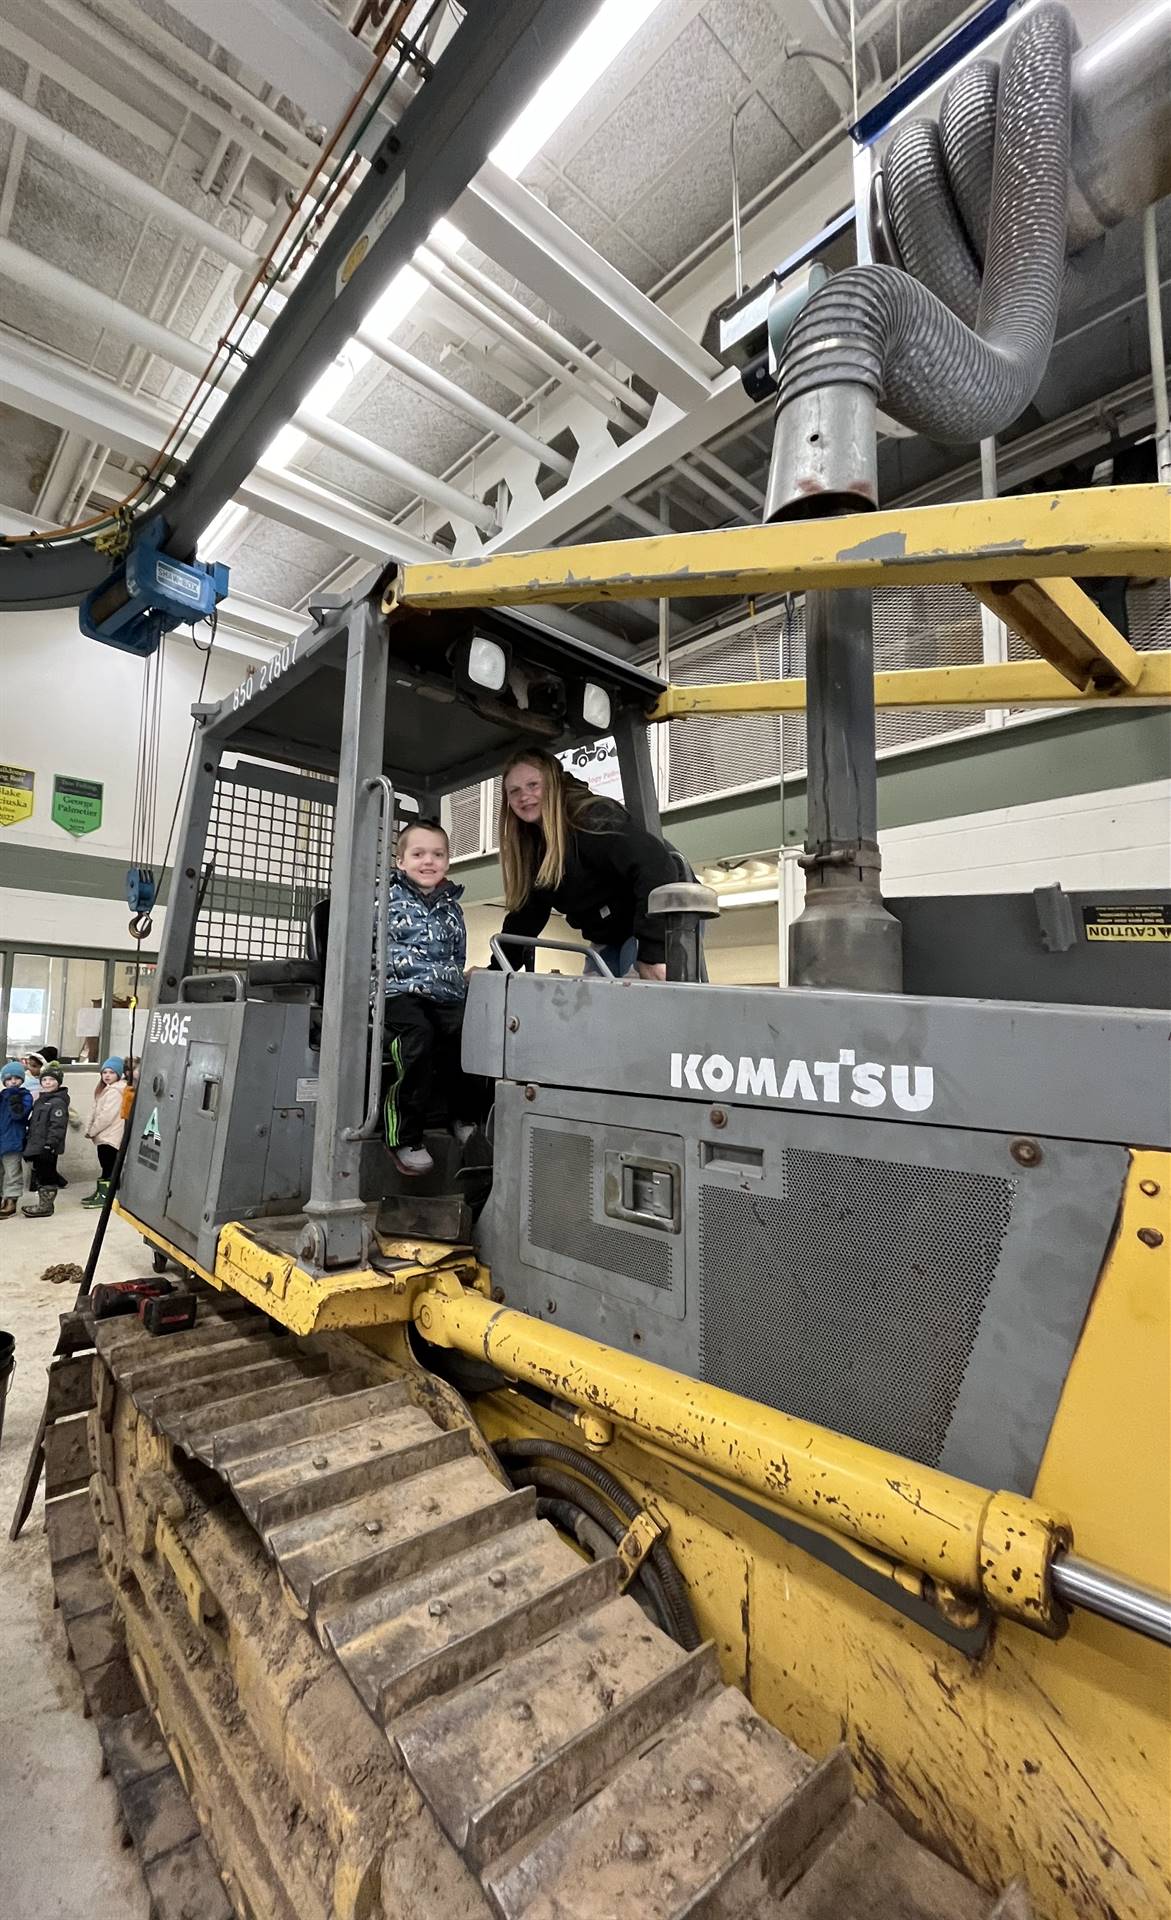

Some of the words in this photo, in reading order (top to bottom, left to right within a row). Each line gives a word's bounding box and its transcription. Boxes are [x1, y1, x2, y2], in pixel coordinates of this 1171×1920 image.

[233, 675, 253, 711] 850
[63, 796, 93, 808] George
[1089, 926, 1156, 937] CAUTION
[149, 1012, 192, 1046] D38E
[670, 1048, 934, 1112] KOMATSU
